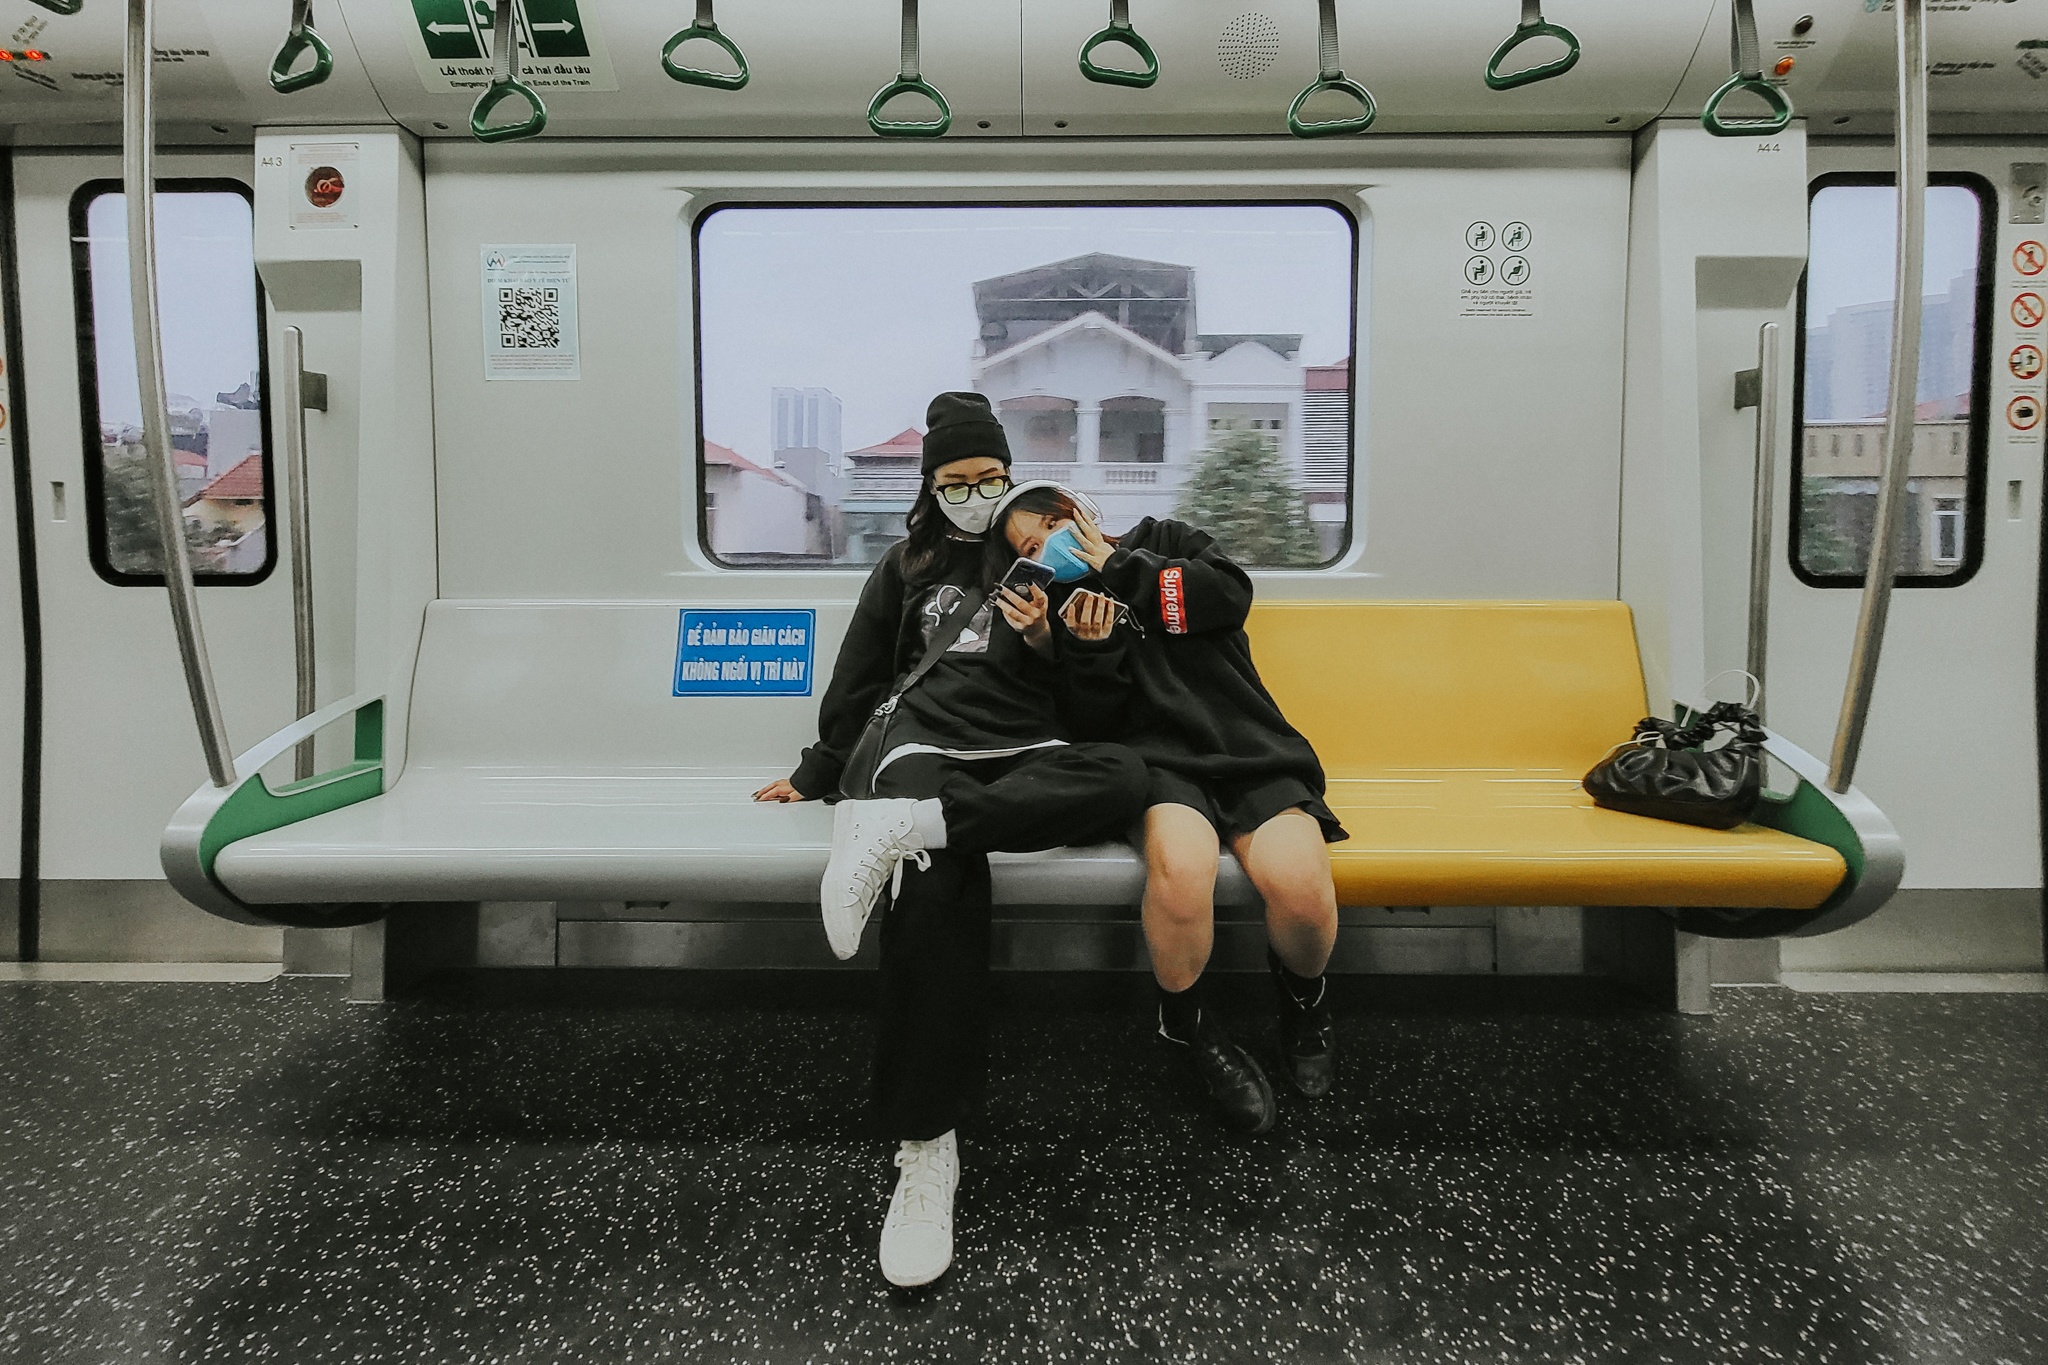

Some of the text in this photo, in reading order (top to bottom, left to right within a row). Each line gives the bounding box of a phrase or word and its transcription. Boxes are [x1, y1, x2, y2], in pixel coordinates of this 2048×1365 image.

[458, 66, 483, 76] thoát
[535, 65, 551, 75] hai
[554, 63, 573, 75] đầu
[574, 65, 591, 74] tàu
[450, 81, 489, 89] Emergency
[1160, 569, 1182, 635] Supreme
[728, 621, 750, 646] BẢO
[777, 624, 806, 646] CÁCH
[681, 657, 720, 681] KHÔNG
